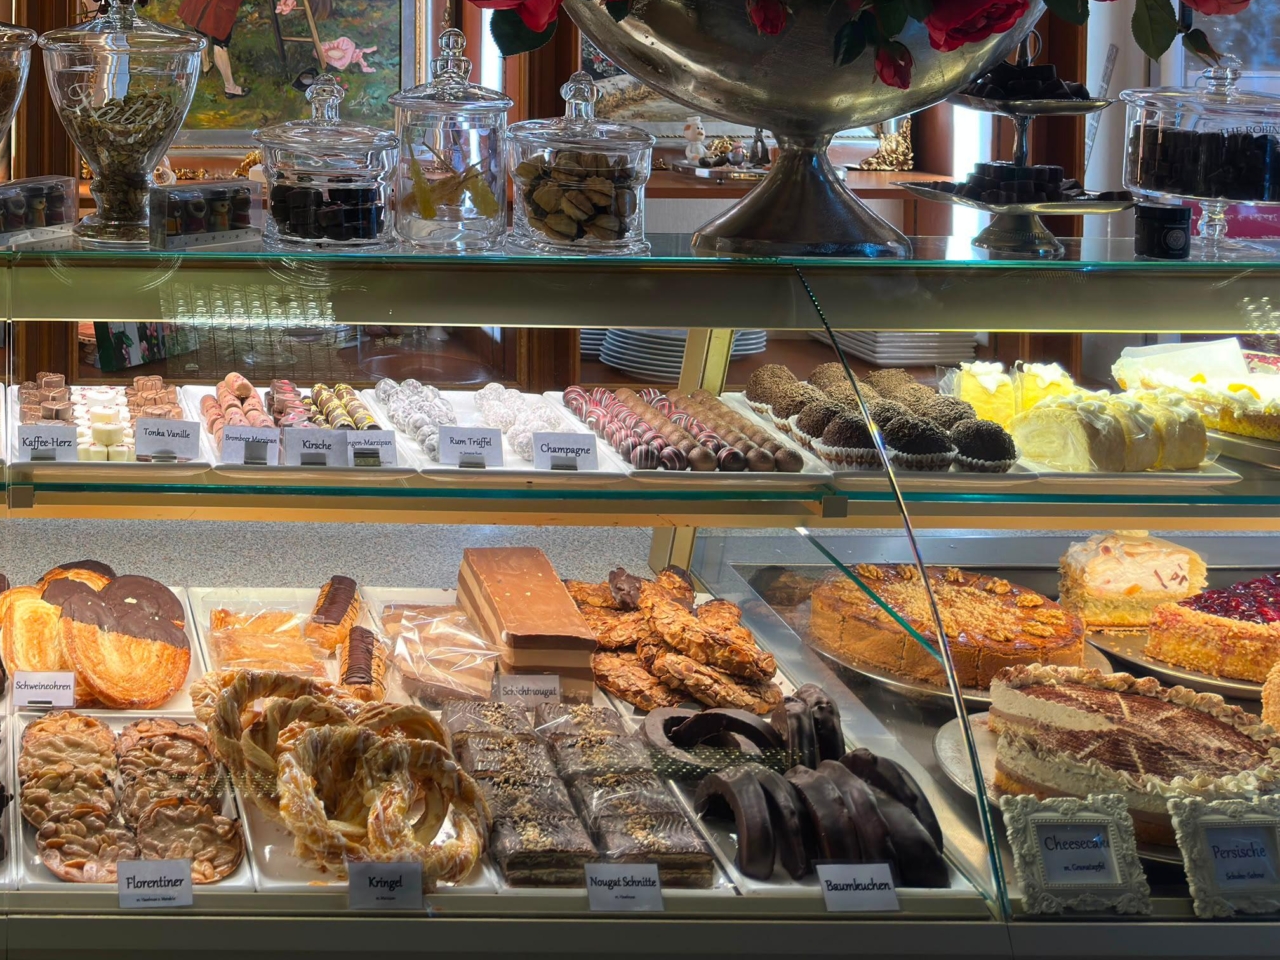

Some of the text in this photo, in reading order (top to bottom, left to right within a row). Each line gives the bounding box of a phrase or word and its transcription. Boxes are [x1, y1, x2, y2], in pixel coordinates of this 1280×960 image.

[143, 427, 191, 439] Tonka Vanille
[250, 435, 278, 444] Marzipan
[22, 436, 72, 451] Kaffee-Herz
[302, 440, 332, 450] Kirsche
[347, 439, 392, 448] ngen-Marzipan
[449, 436, 492, 449] Rum Trüffel
[540, 443, 591, 458] Champagne
[15, 680, 71, 690] Schweineohren
[1044, 834, 1110, 851] Cheesecak
[1211, 842, 1267, 859] Persische
[125, 874, 185, 890] Florentiner
[368, 875, 403, 891] Kringel
[589, 874, 657, 891] Nougat Schnitte
[824, 879, 892, 893] Baumkuchen
